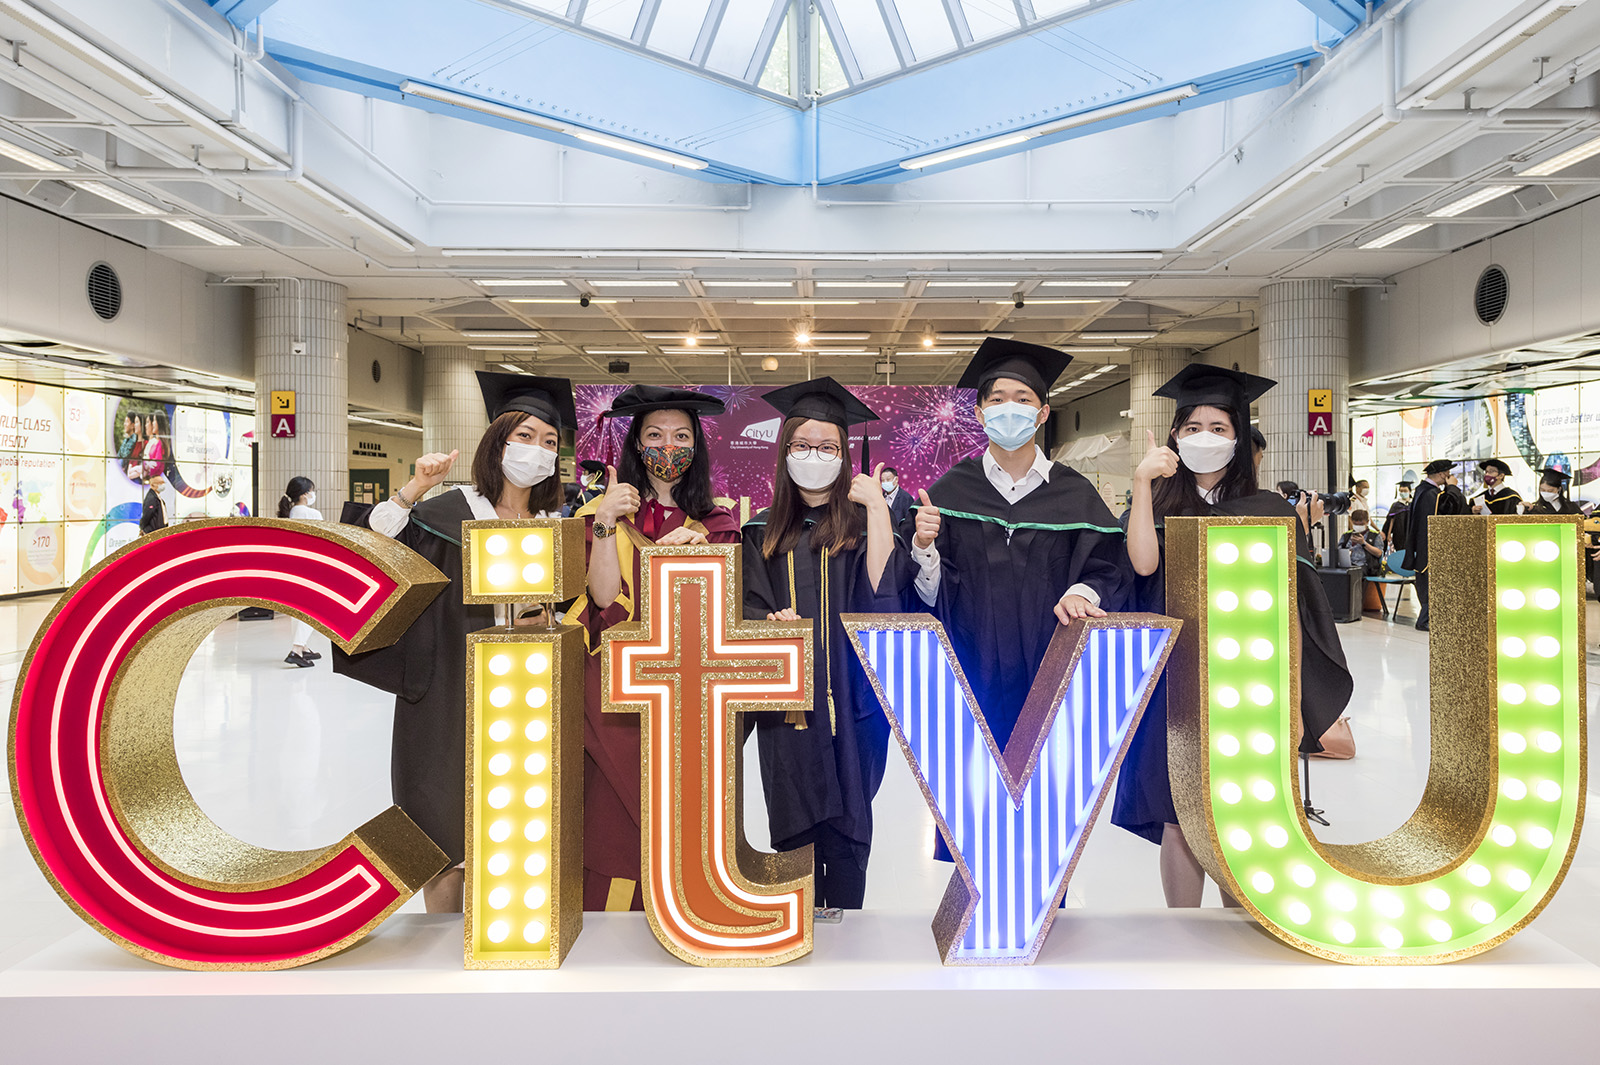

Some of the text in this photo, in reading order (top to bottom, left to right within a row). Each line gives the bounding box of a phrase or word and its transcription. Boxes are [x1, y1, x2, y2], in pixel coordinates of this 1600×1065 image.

[276, 418, 291, 434] A
[1313, 416, 1328, 432] A
[1541, 416, 1563, 427] create
[1564, 416, 1569, 424] a
[1570, 413, 1593, 424] better
[746, 428, 774, 441] CityU
[21, 459, 55, 468] reputation
[8, 516, 1587, 971] CityU
